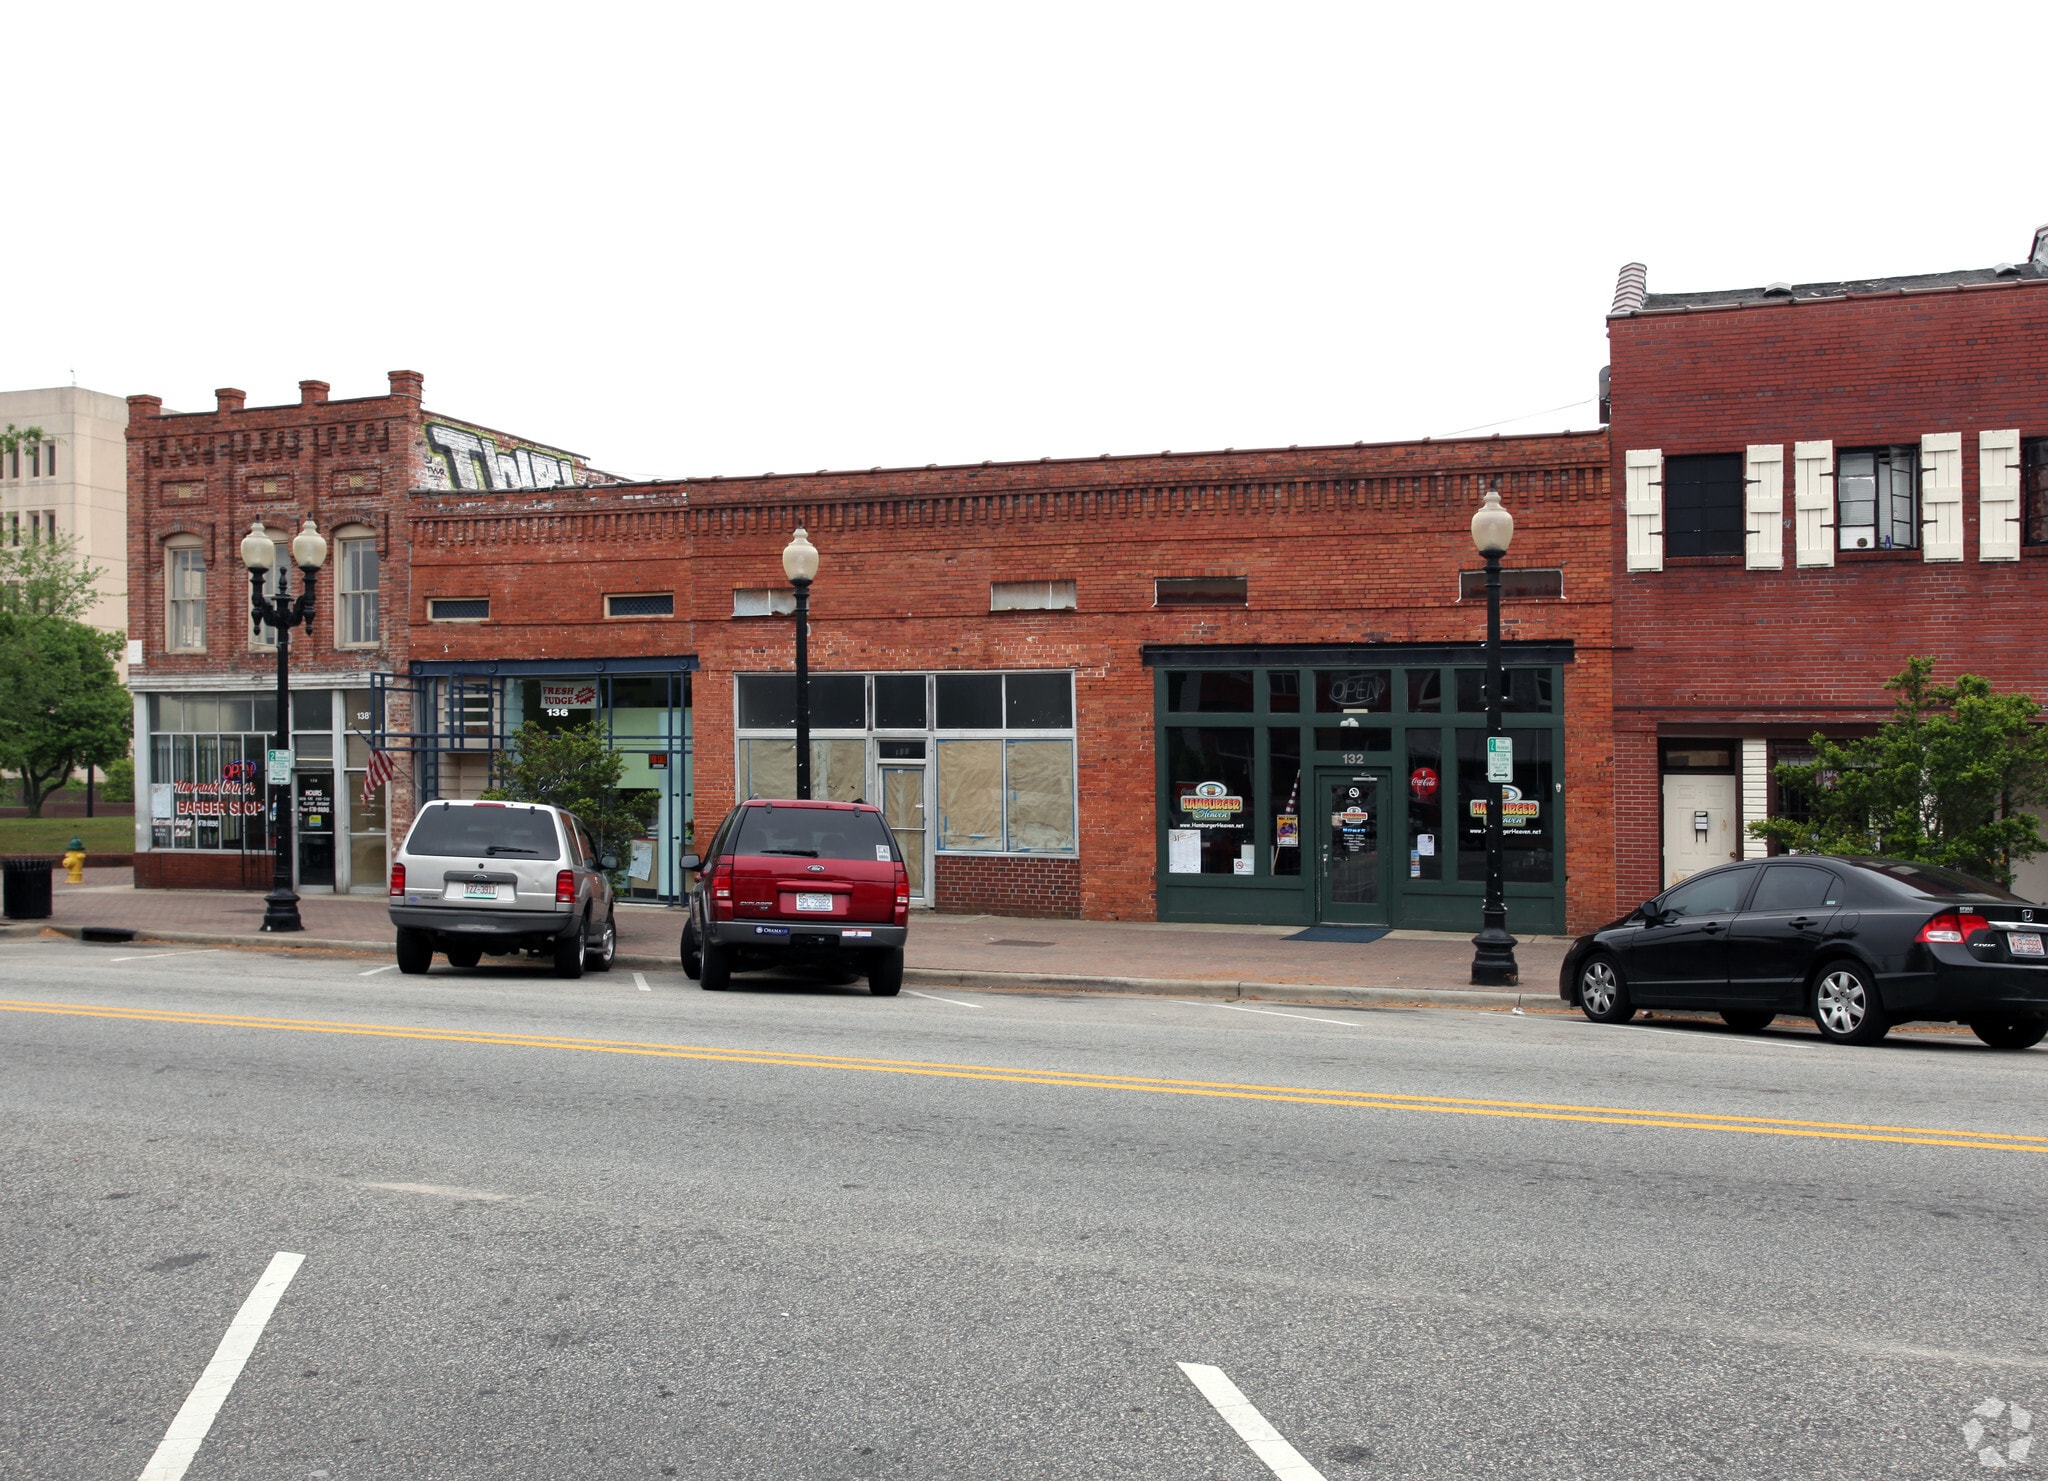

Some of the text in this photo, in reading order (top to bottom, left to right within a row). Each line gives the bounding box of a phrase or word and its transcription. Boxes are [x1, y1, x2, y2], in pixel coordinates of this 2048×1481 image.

[543, 686, 574, 695] FRESH
[1331, 680, 1381, 700] OPEN
[544, 696, 574, 705] FUDGE
[546, 708, 569, 717] 136
[270, 752, 276, 761] 2
[1342, 753, 1364, 765] 132
[304, 789, 323, 797] HOURS
[177, 800, 226, 816] BARBER
[1183, 797, 1240, 811] HAMBURGER
[1472, 802, 1537, 816] HAURGER
[1196, 808, 1228, 819] Heaven
